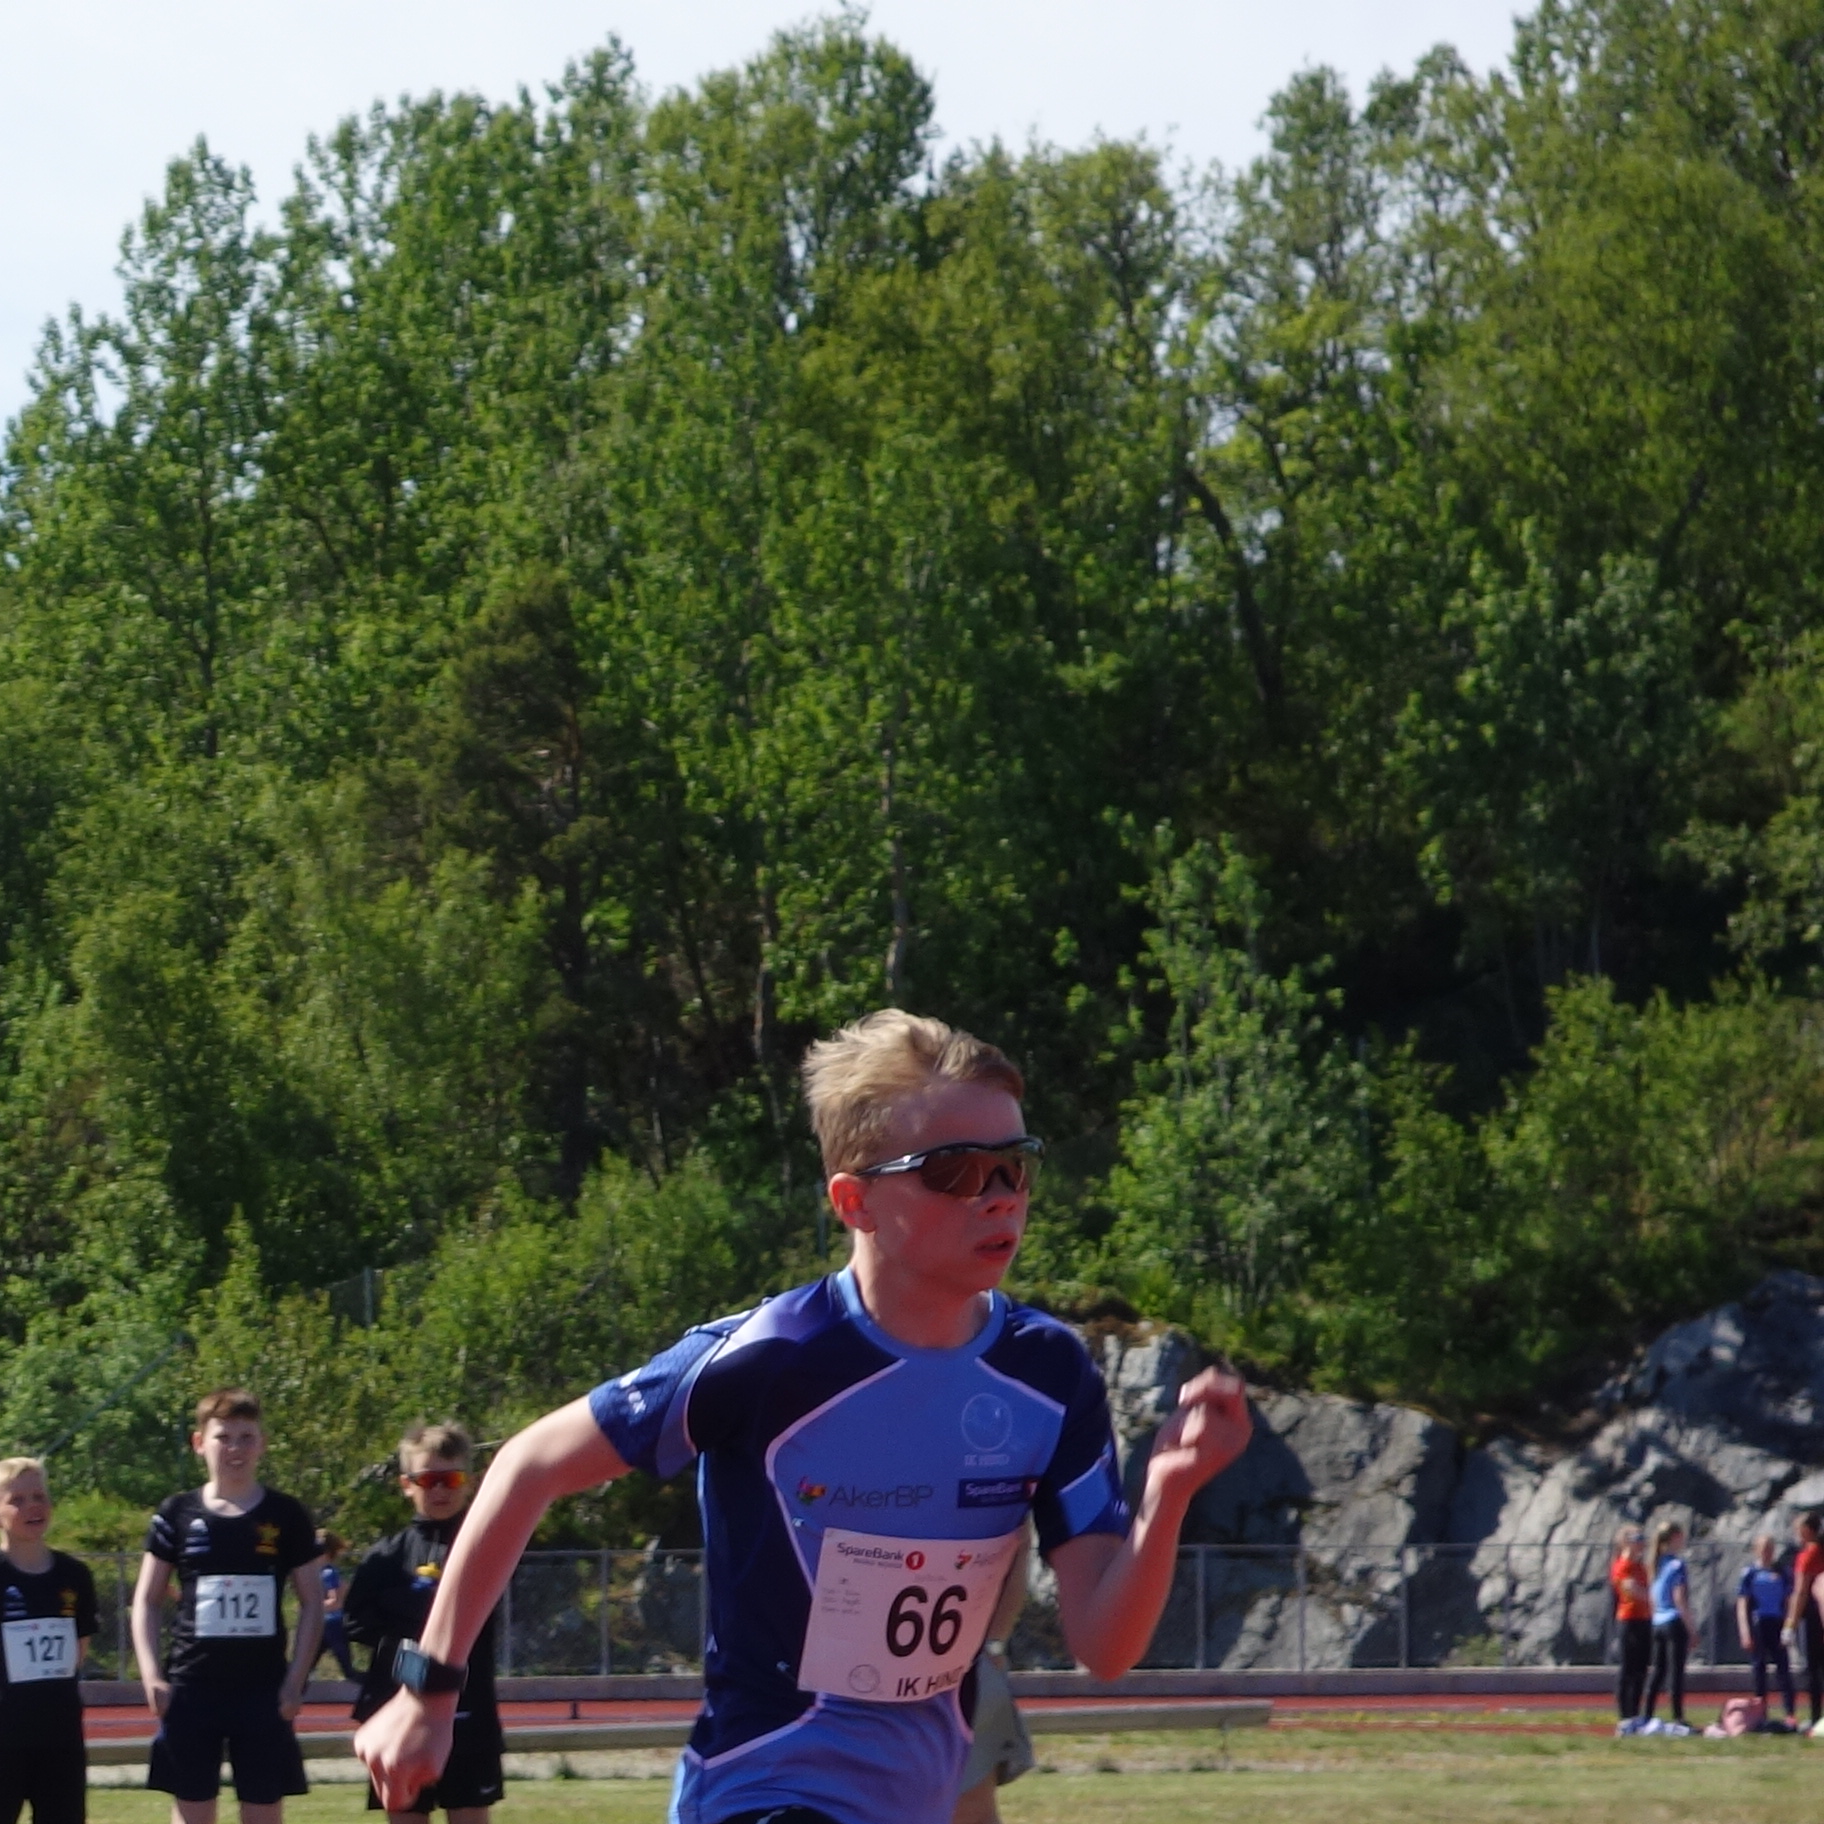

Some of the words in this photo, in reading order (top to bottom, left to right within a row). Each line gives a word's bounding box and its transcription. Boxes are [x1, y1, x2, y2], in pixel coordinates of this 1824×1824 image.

[828, 1484, 934, 1508] AkerBP
[836, 1541, 904, 1562] SpareBank
[216, 1591, 261, 1619] 112
[885, 1584, 968, 1658] 66
[23, 1634, 66, 1663] 127
[896, 1676, 921, 1697] IK
